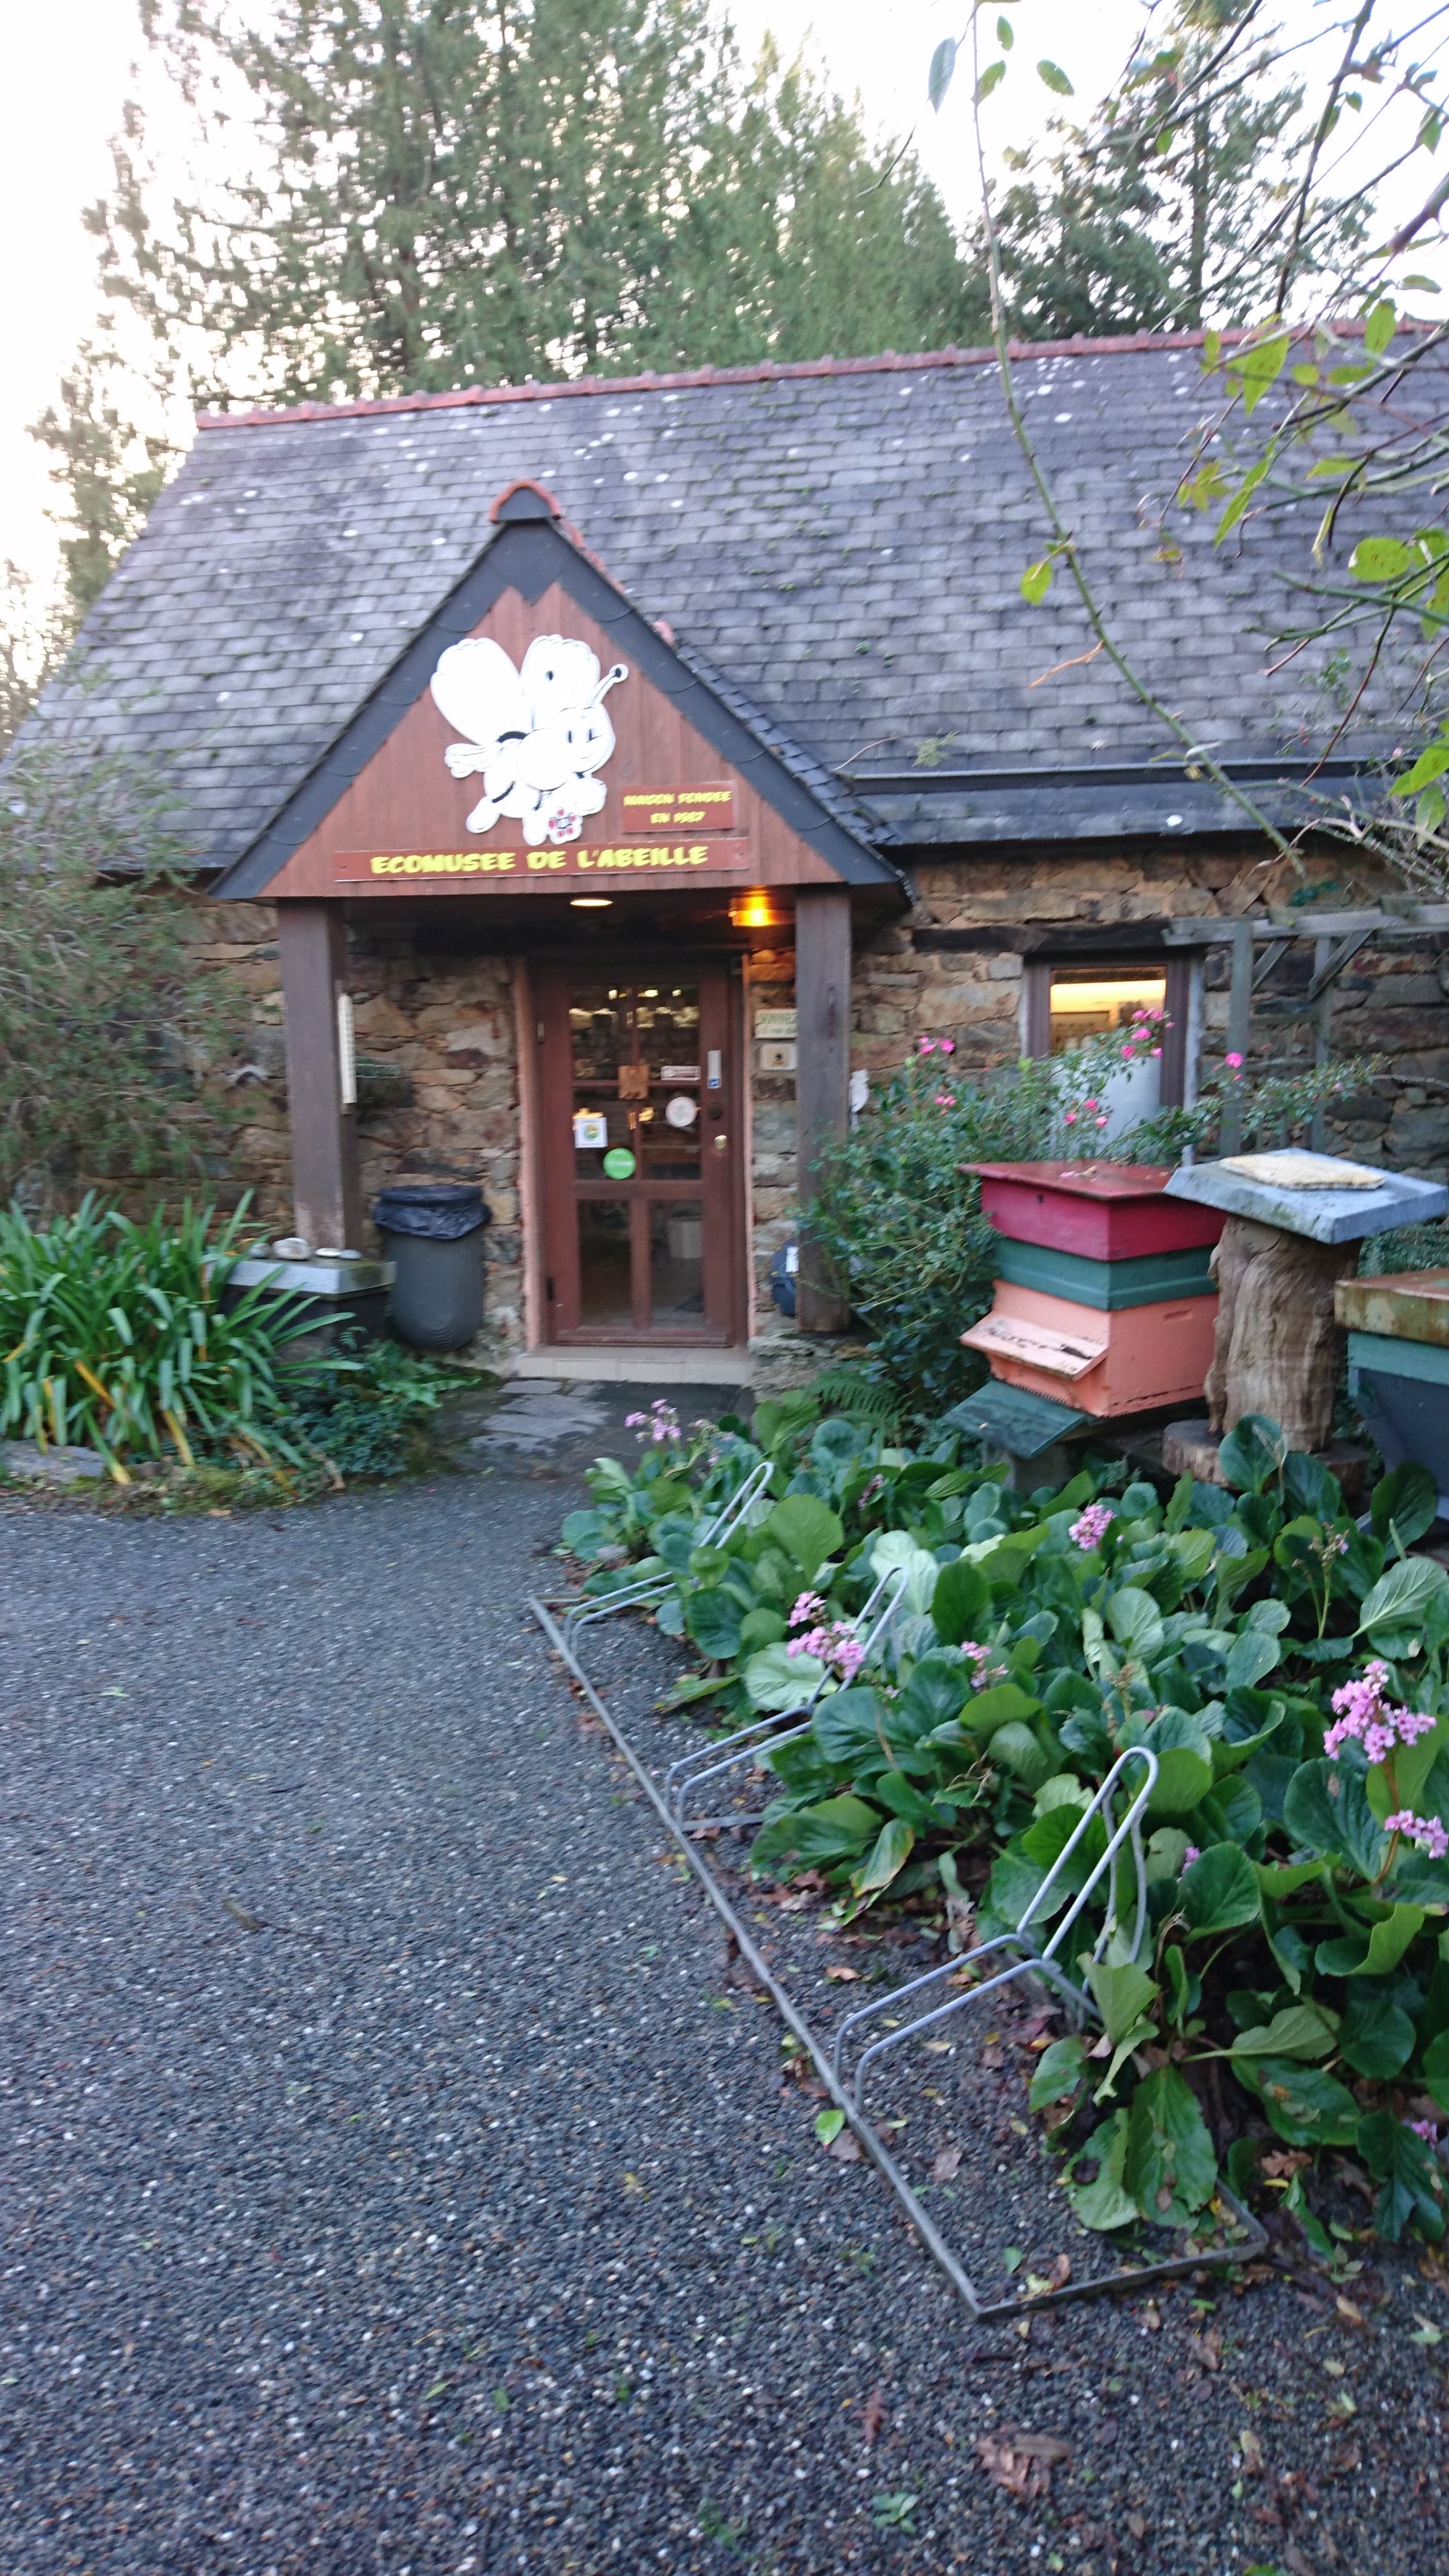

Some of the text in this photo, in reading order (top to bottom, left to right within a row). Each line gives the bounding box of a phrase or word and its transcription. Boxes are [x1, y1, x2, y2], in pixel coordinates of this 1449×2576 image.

[650, 812, 671, 824] EN
[370, 846, 708, 873] ECOMUSEE DE L'ABEILLE
